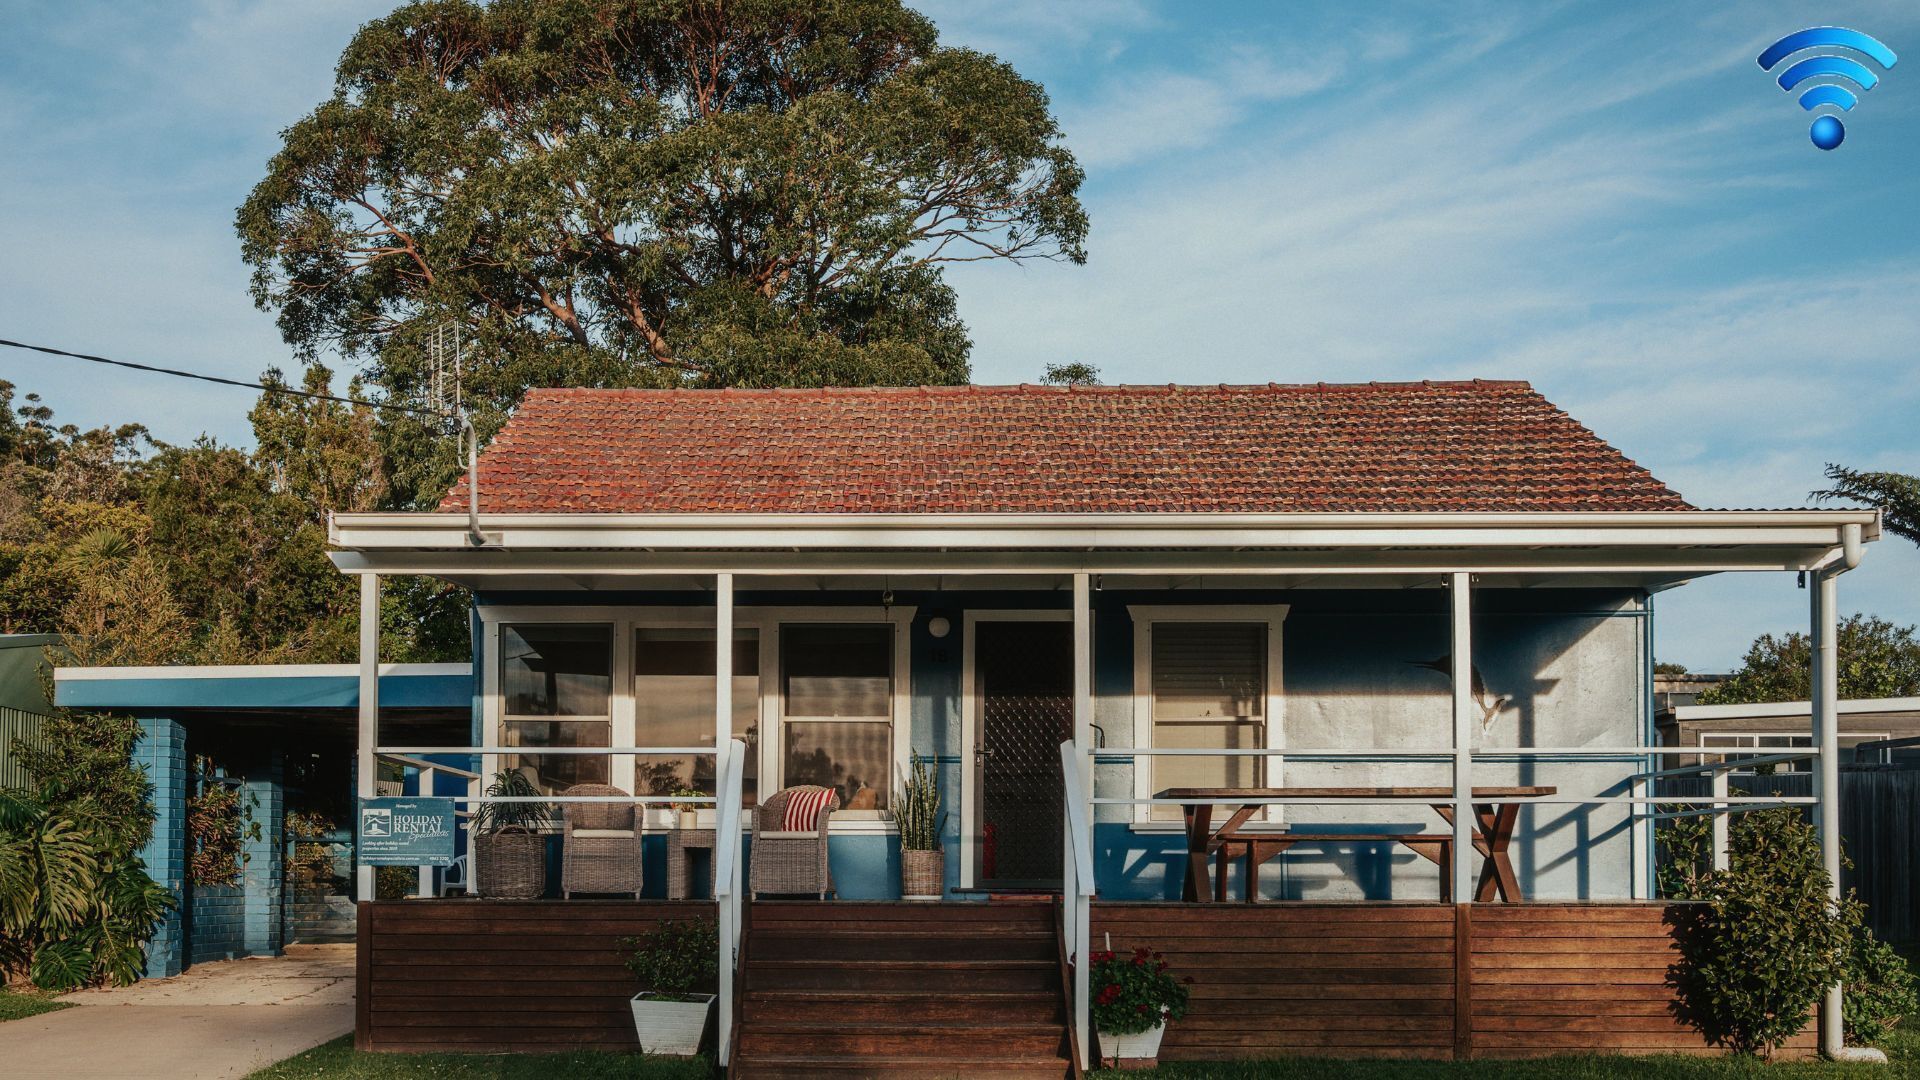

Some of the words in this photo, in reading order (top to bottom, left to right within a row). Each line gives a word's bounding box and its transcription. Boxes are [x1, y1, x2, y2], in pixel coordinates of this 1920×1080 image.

[393, 815, 444, 824] HOLIDAY
[393, 824, 441, 833] RENTAL
[408, 830, 450, 842] Specialists
